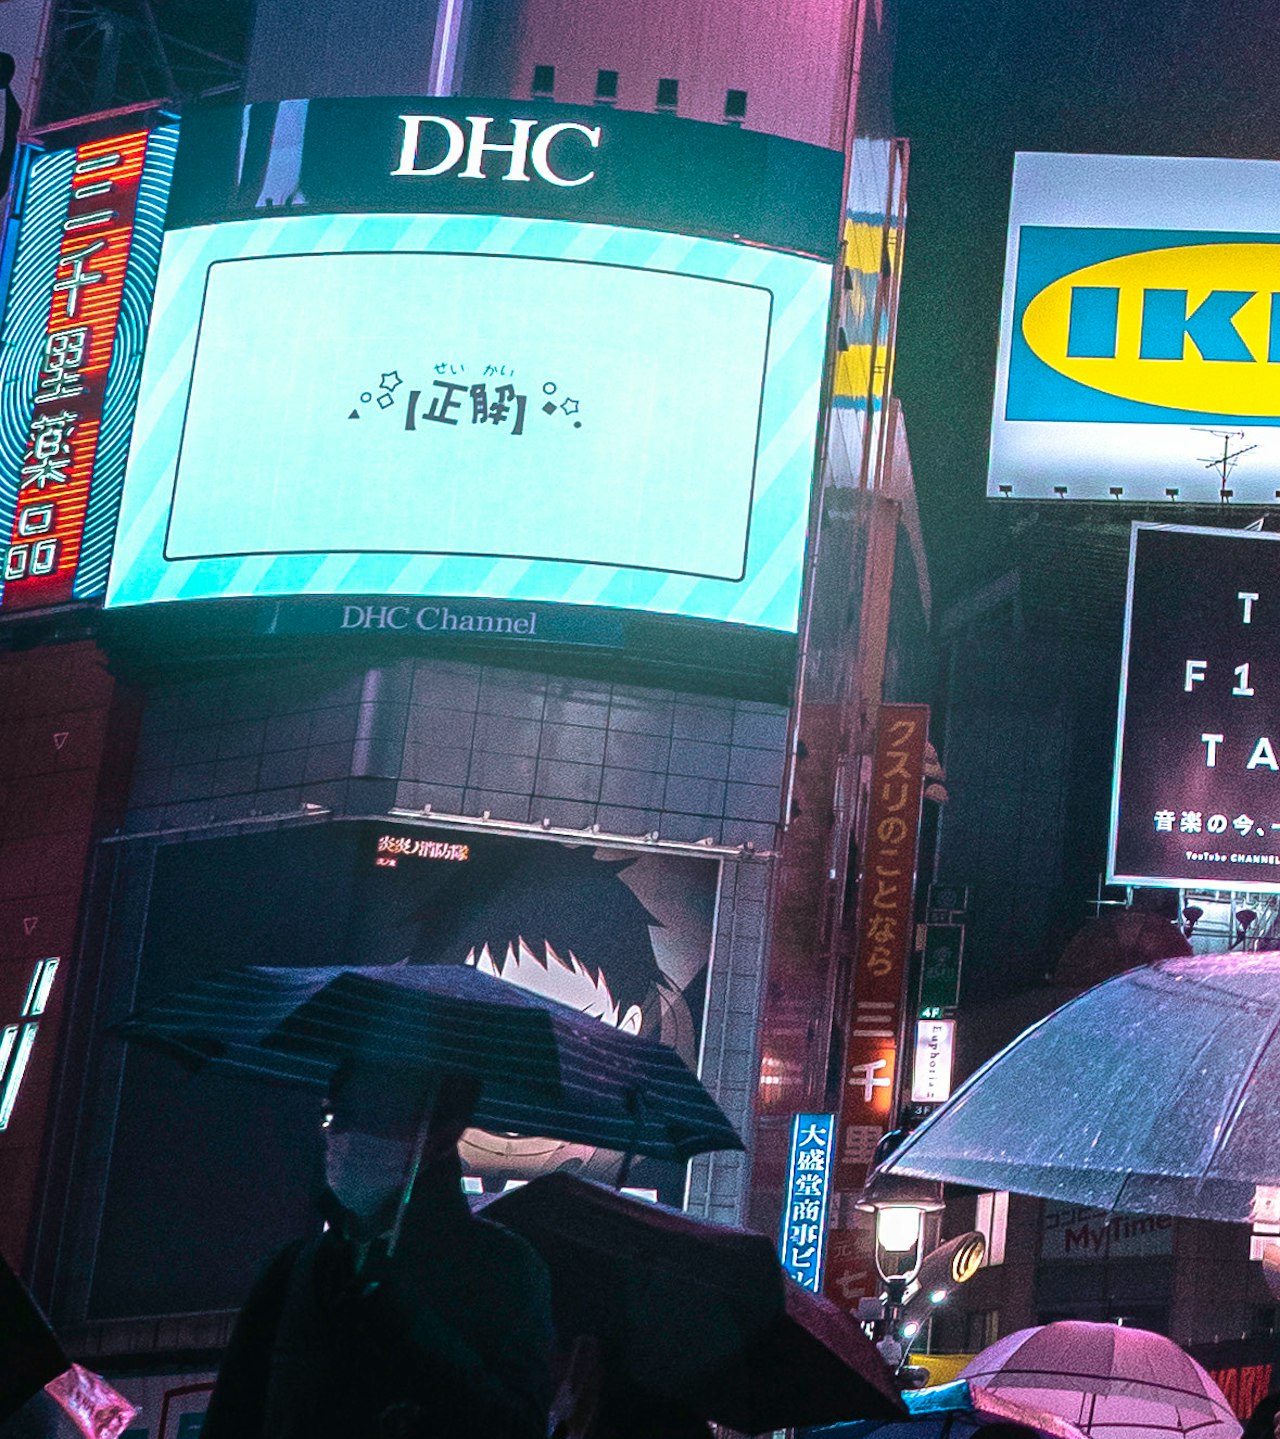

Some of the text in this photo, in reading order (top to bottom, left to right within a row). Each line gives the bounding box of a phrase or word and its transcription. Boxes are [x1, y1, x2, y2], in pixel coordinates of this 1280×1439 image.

[390, 114, 601, 187] DHC
[433, 362, 465, 377] せい
[341, 606, 537, 636] DHC Channel
[1185, 851, 1227, 863] YouTube
[1230, 853, 1280, 865] CHANNEL
[922, 1007, 940, 1018] 4F
